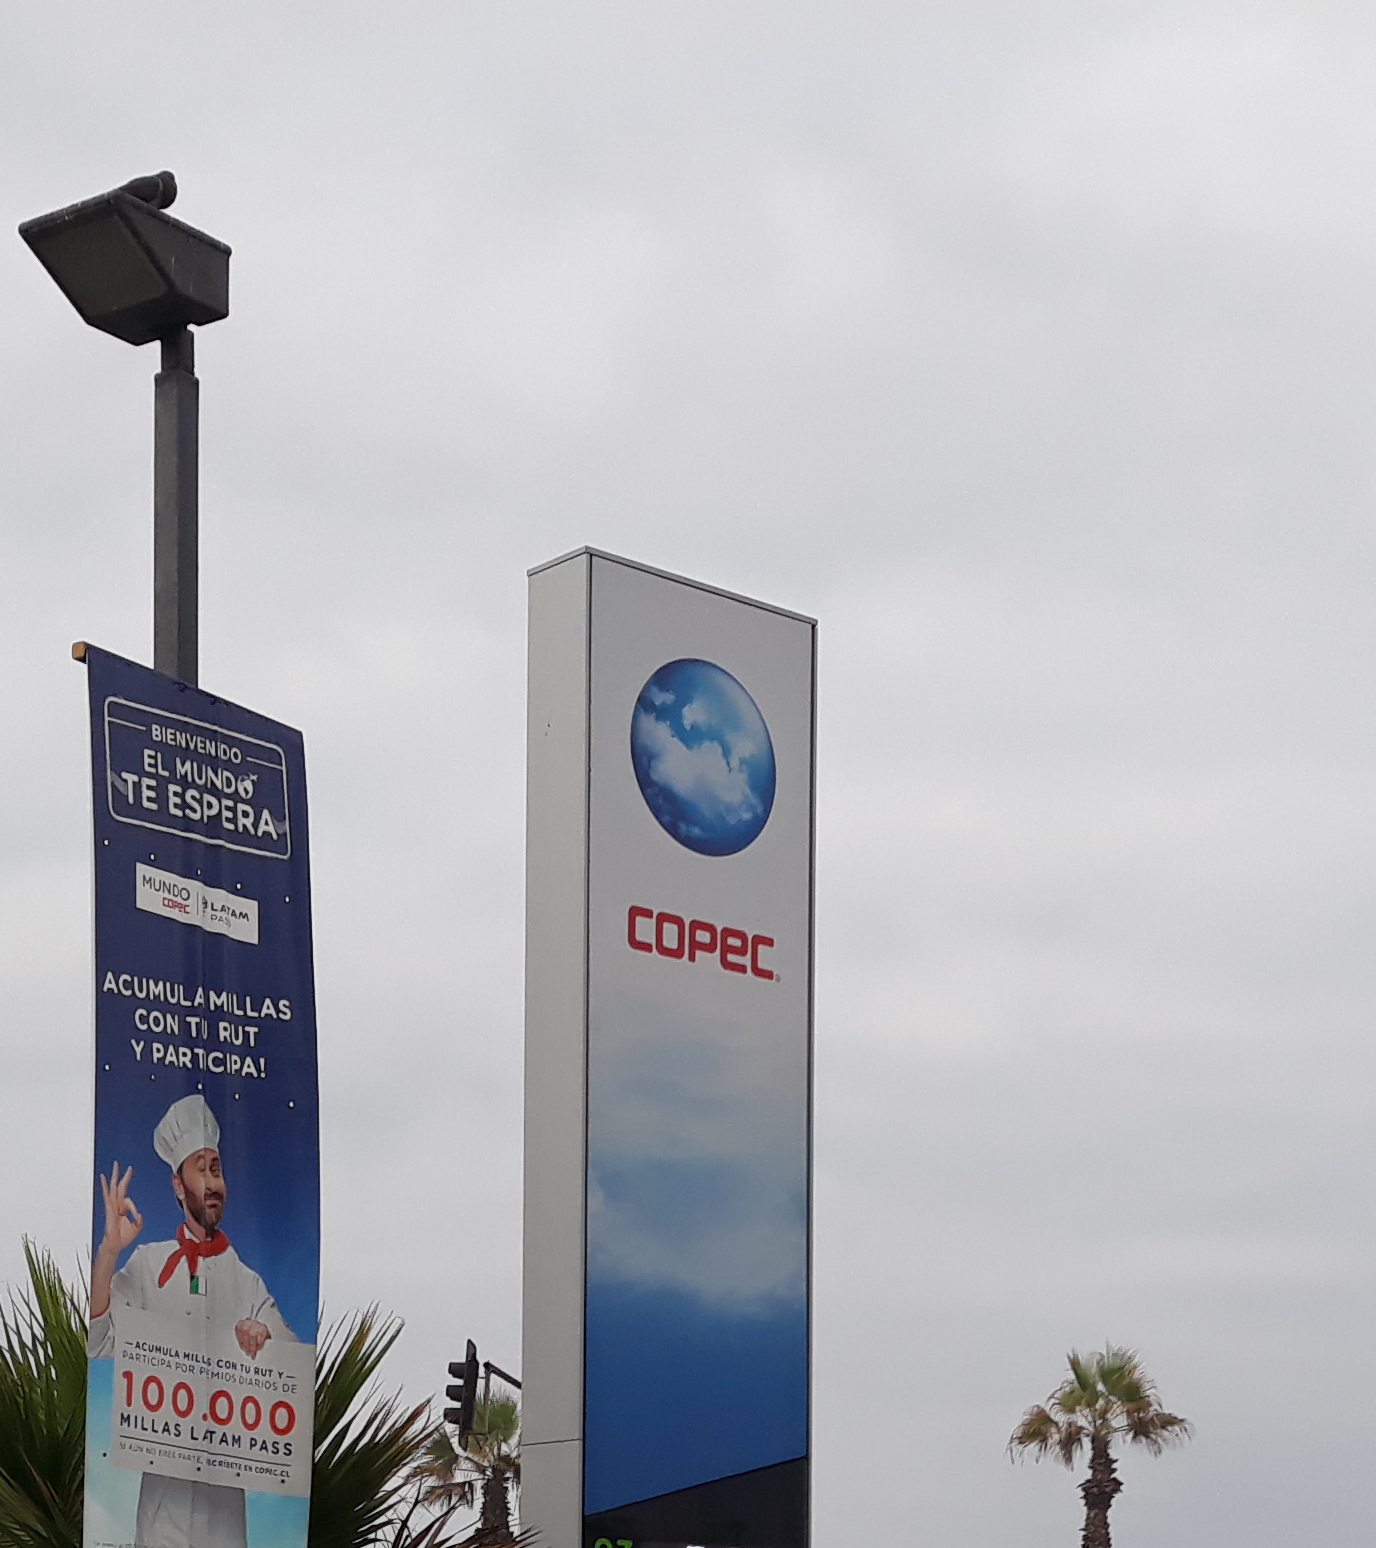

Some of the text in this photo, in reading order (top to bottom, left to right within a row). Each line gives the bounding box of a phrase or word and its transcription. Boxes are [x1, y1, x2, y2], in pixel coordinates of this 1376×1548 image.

[151, 724, 242, 764] BIENVENIDO
[143, 749, 256, 800] EL MUNDO
[121, 772, 278, 841] TE ESPERA
[142, 874, 249, 922] MUNDO LATAM
[102, 971, 292, 1021] ACUMULA MILLAS
[135, 1008, 259, 1047] CON TU RUT
[131, 1039, 266, 1078] Y PARTICIPA!
[122, 1350, 172, 1369] PARTICIPA
[175, 1361, 195, 1374] POR
[238, 1375, 278, 1391] DIARIOS
[282, 1383, 298, 1394] DE
[135, 1340, 180, 1359] ACUMULA
[216, 1359, 237, 1371] CON
[240, 1362, 251, 1374] TU
[254, 1366, 273, 1378] RUT
[277, 1370, 284, 1380] Y
[122, 1370, 296, 1436] 100.000
[120, 1412, 293, 1457] MILLAS LATAM PASS
